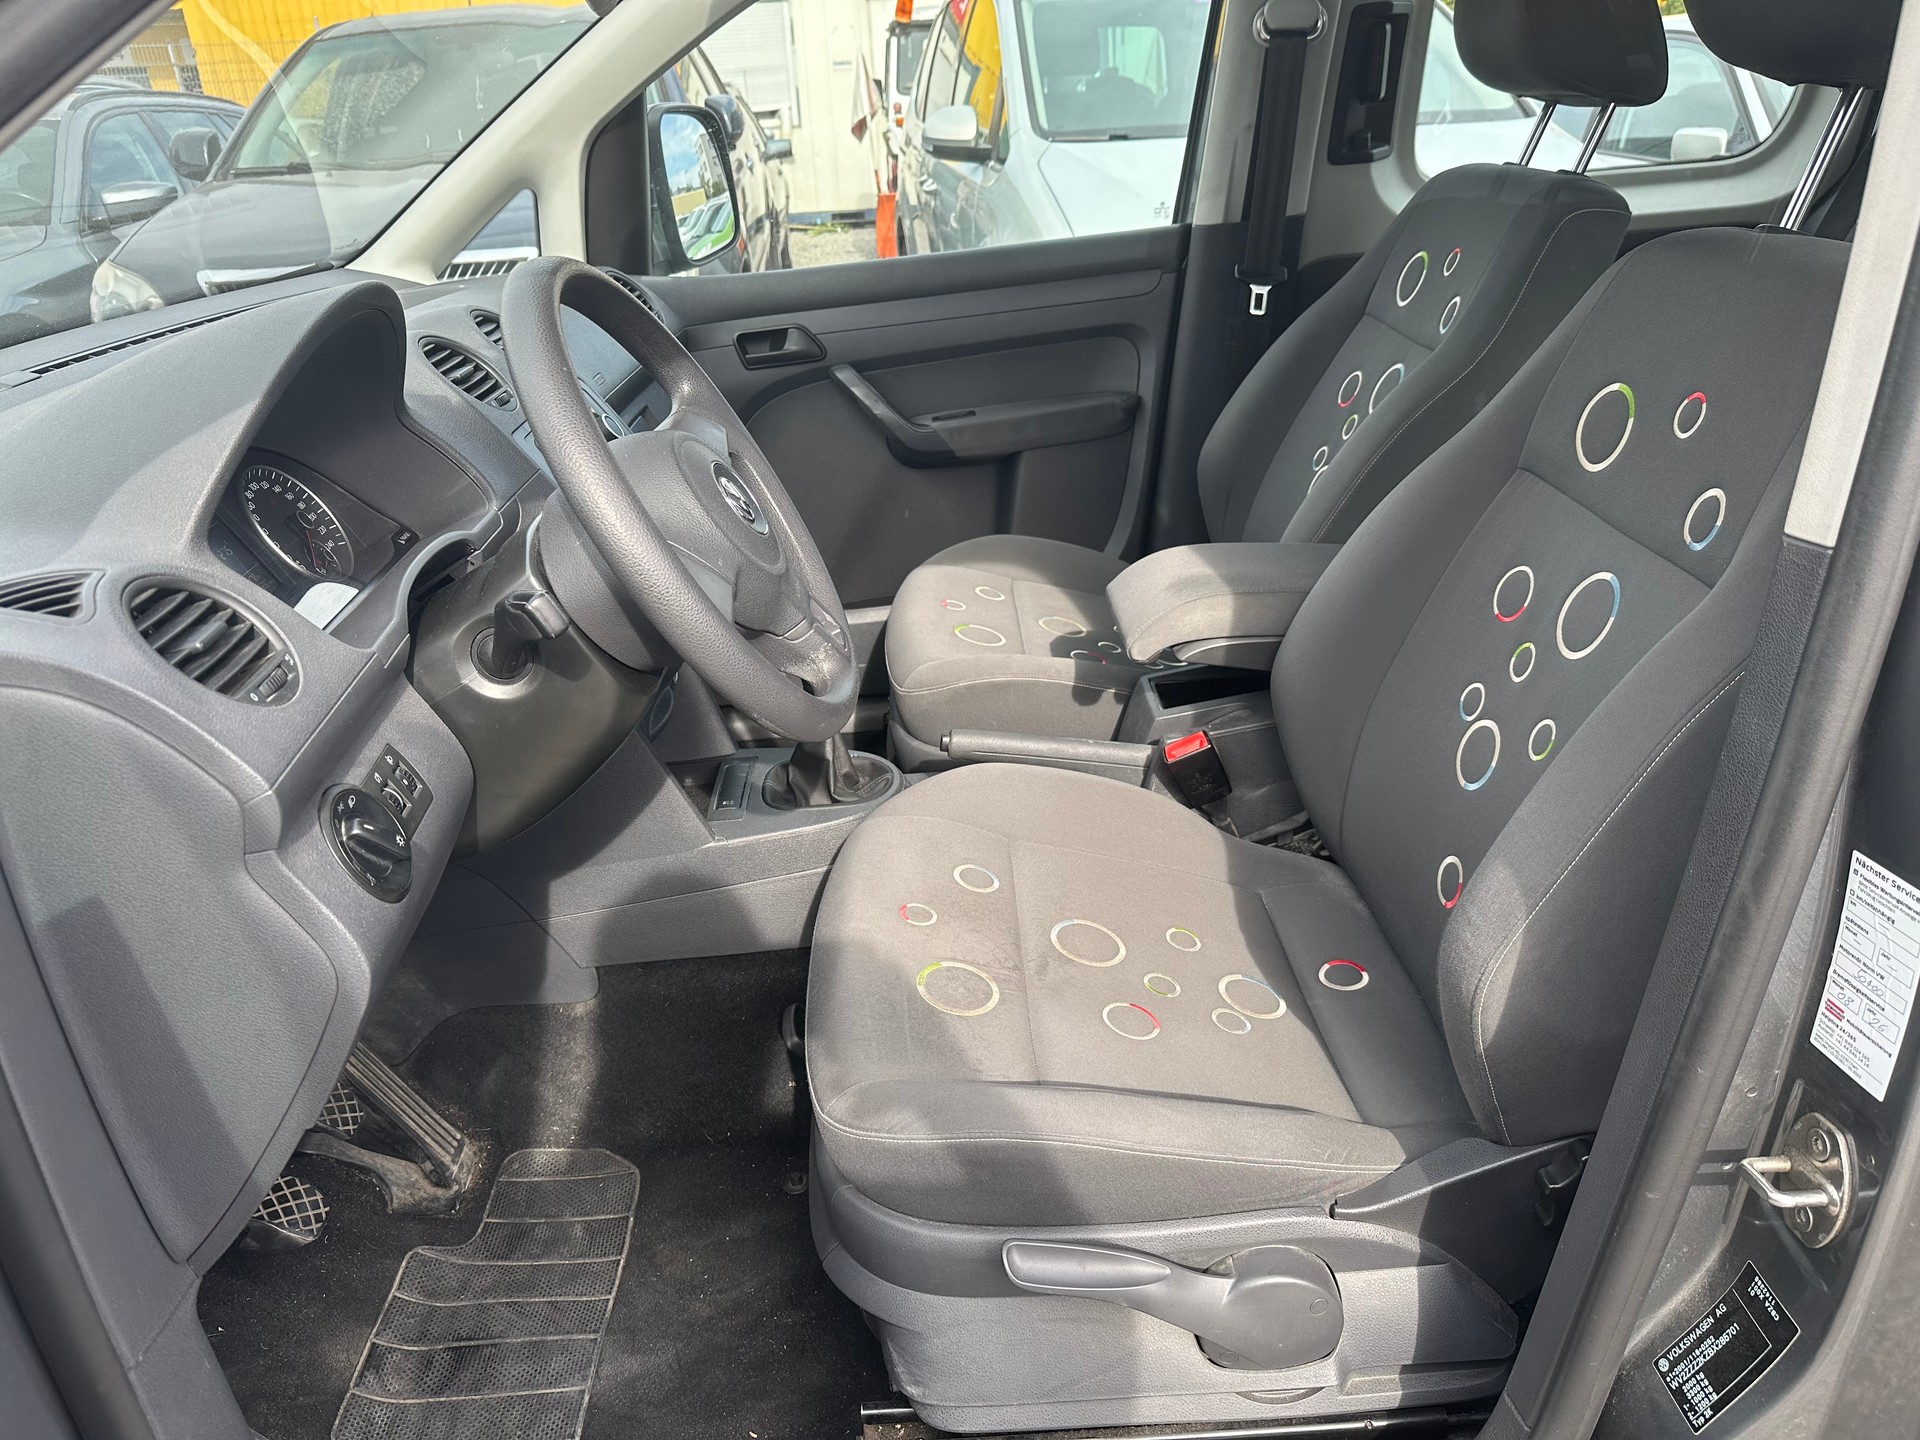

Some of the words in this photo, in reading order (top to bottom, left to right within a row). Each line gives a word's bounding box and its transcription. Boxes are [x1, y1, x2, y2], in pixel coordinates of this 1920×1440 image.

[1855, 856, 1890, 884] Nächster
[1891, 879, 1920, 905] Service
[1845, 915, 1869, 935] spätestens
[1862, 961, 1876, 975] Norm
[1875, 971, 1885, 982] VW
[1837, 991, 1855, 1008] 08
[1821, 1011, 1839, 1030] Helpline
[1839, 1025, 1857, 1043] 24/365
[1869, 1016, 1889, 1033] 26
[1666, 1314, 1715, 1363] VOLKSWAGEN
[1714, 1302, 1727, 1318] AG
[1681, 1376, 1698, 1394] 2000
[1695, 1371, 1705, 1381] kg
[1685, 1383, 1702, 1401] 3300
[1699, 1378, 1710, 1388] kg
[1690, 1390, 1706, 1406] 1000
[1703, 1384, 1714, 1395] kg
[1694, 1397, 1710, 1413] 1200
[1692, 1415, 1705, 1428] Typ
[1703, 1406, 1714, 1420] 2K
